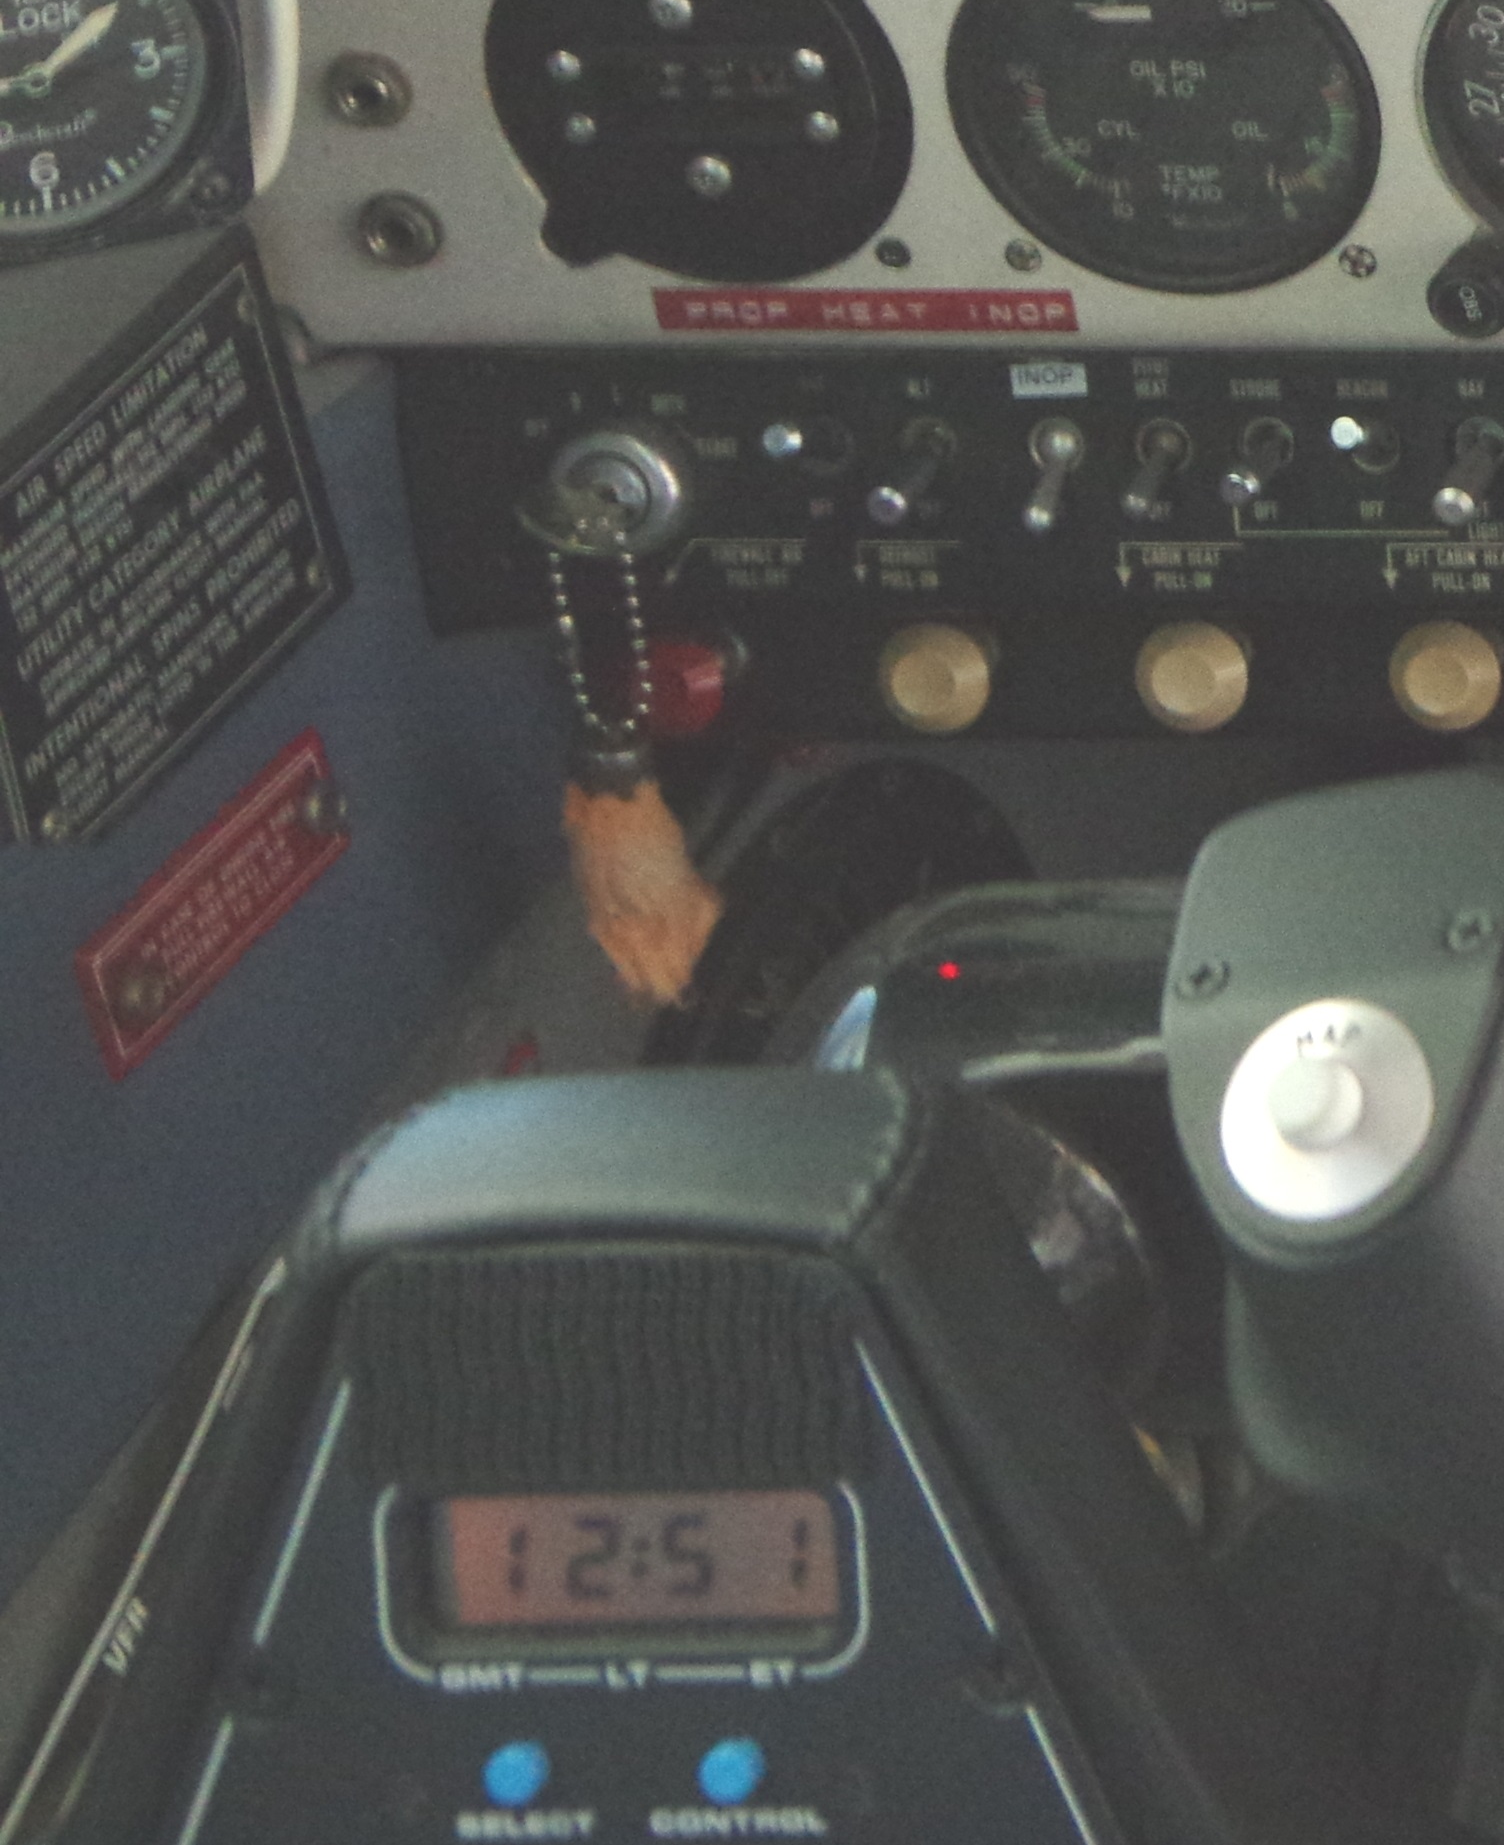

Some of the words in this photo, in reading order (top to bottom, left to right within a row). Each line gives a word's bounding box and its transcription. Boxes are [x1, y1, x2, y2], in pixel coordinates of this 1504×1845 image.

[685, 302, 789, 323] PROP
[822, 303, 929, 324] HEAT
[968, 304, 1069, 325] INOP
[1017, 368, 1073, 387] INOP
[509, 1514, 811, 1602] 12:51
[456, 1811, 594, 1838] SELECT
[650, 1808, 827, 1836] CONTROL
